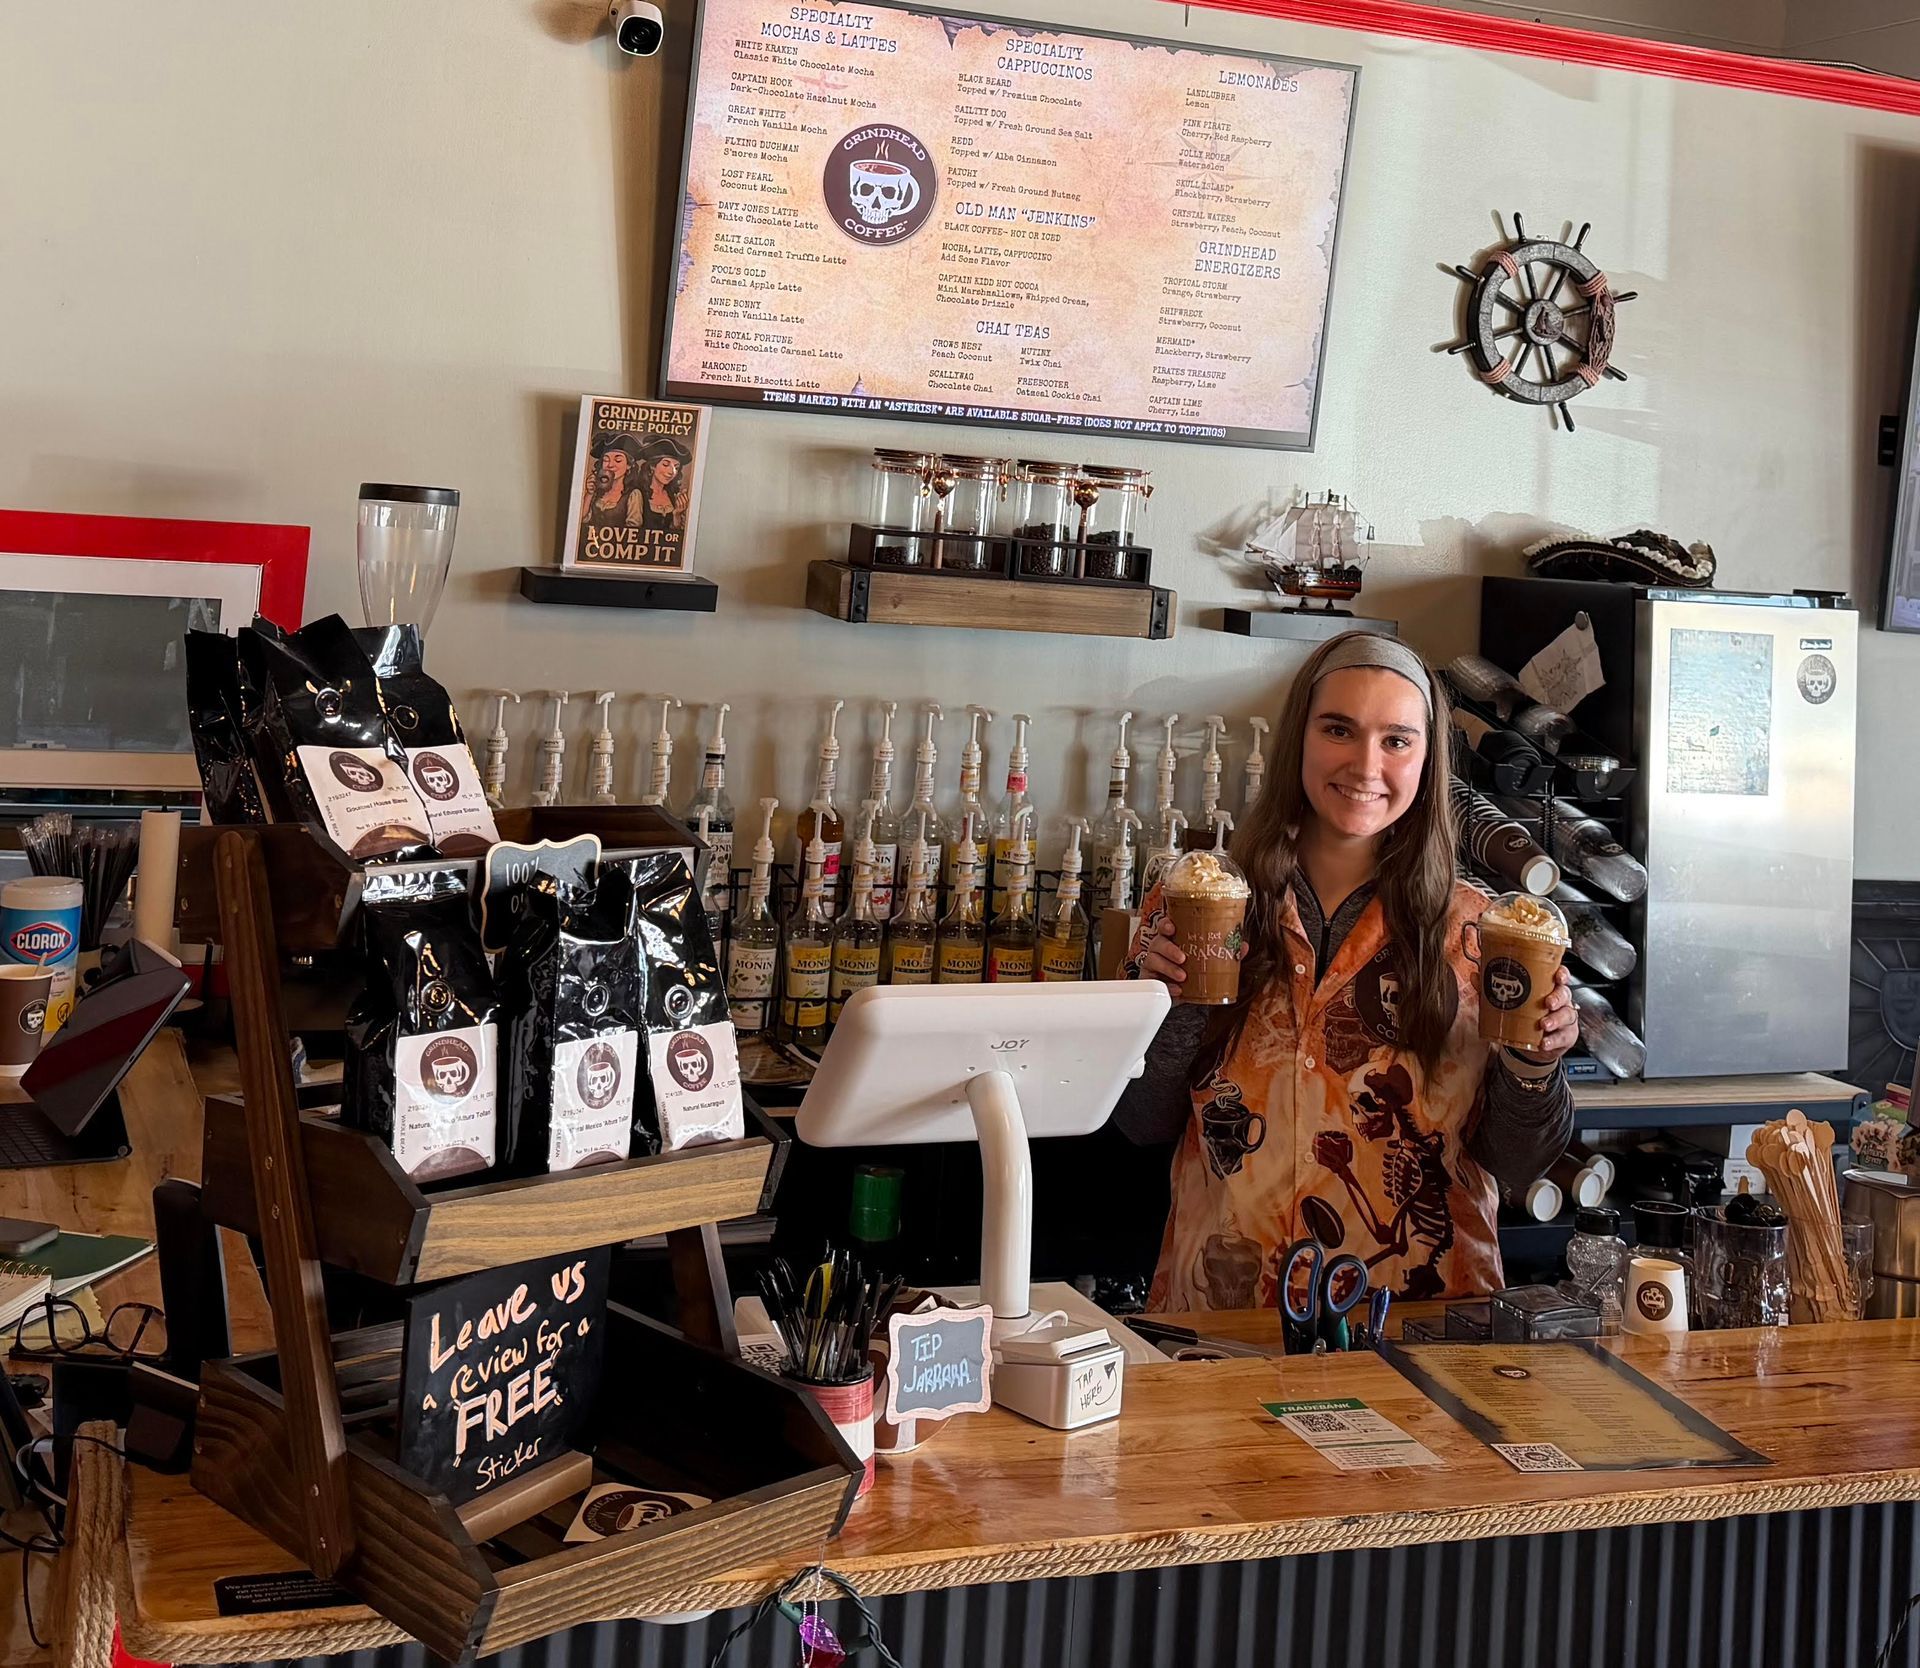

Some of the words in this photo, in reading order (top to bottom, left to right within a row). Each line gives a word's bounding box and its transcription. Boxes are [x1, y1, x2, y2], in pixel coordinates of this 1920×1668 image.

[790, 6, 873, 30] SPECIALTY
[760, 22, 820, 42] MOCHAS
[825, 31, 835, 44] &
[840, 32, 896, 52] LATTES
[735, 39, 762, 50] WHITE
[765, 43, 798, 55] KRAKEN
[1006, 38, 1084, 60] SPECIALTY
[733, 49, 769, 62] Classic
[772, 55, 797, 66] White
[799, 59, 845, 72] Chocolate
[847, 66, 874, 76] Mocha
[997, 56, 1092, 80] CAPPUCCINOS
[731, 71, 767, 83] CAPTAIN
[770, 76, 792, 87] HOOK
[958, 73, 983, 83] BLACK
[985, 76, 1011, 87] BEARD
[1218, 70, 1297, 92] LEMONADES
[1186, 87, 1235, 101] LANDLUBBER
[1185, 98, 1209, 108] Lemon
[728, 104, 756, 115] GREAT
[758, 108, 786, 119] WHITE
[1182, 118, 1201, 127] PINK
[1203, 120, 1231, 131] PIRATE
[724, 136, 756, 147] FLYING
[759, 140, 799, 152] DUCHMAN
[842, 128, 926, 162] GRINDHEAD
[951, 136, 973, 145] REDD
[721, 168, 744, 178] LOST
[746, 171, 773, 182] PEARL
[947, 166, 977, 177] PATCHY
[720, 179, 757, 191] Coconut
[760, 184, 787, 194] Mocha
[718, 200, 740, 210] DAVY
[741, 203, 769, 214] JONES
[772, 206, 798, 217] LATTE
[955, 201, 983, 216] OLD
[988, 205, 1016, 220] MAN
[1172, 208, 1205, 219] CRYSTAL
[1207, 212, 1236, 222] WATERS
[844, 217, 905, 239] COFFEE
[944, 222, 969, 232] BLACK
[1010, 229, 1026, 238] HOT
[1028, 231, 1039, 239] OR
[1041, 232, 1061, 242] ICED
[714, 233, 741, 243] SALTY
[743, 236, 775, 246] SAILOR
[942, 242, 971, 254] MOCHA,
[973, 245, 1001, 257] LATTE,
[1003, 249, 1052, 261] CAPPUCCINO
[1199, 240, 1276, 260] GRINDHEAD
[743, 268, 766, 277] GOLD
[1194, 259, 1280, 279] ENERGIZERS
[938, 273, 972, 284] CAPTAIN
[974, 277, 994, 286] KIDD
[996, 279, 1012, 288] HOT
[1014, 281, 1038, 291] COCOA
[1163, 276, 1200, 287] TROPICAL
[1202, 280, 1227, 290] STORM
[708, 297, 731, 306] ANNE
[733, 299, 761, 309] BONNY
[1159, 306, 1203, 318] SHIPWRECK
[704, 328, 722, 338] THE
[724, 330, 751, 340] ROYAL
[754, 333, 792, 344] FORTUNE
[976, 320, 1010, 336] CHAI
[1014, 324, 1049, 339] TEAS
[932, 338, 958, 348] CROWS
[961, 341, 982, 350] NEST
[1020, 347, 1051, 356] MUTINY
[701, 360, 747, 372] MAROONED
[1152, 366, 1185, 376] PIRATES
[1187, 369, 1226, 379] TREASURE
[928, 369, 973, 380] SCALLYWAG
[1017, 377, 1069, 388] FREEBOOTER
[1149, 395, 1180, 405] CAPTAIN
[1182, 398, 1202, 407] LIME
[598, 404, 694, 425] GRINDHEAD
[763, 390, 796, 402] ITEMS
[798, 394, 838, 406] MARKED
[841, 397, 866, 408] WITH
[868, 399, 881, 409] AN
[944, 406, 964, 416] ARE
[966, 407, 1018, 420] AVAILABLE
[1020, 412, 1082, 425] SUGAR-FREE
[1113, 419, 1132, 429] NOT
[1134, 421, 1162, 432] APPLY
[1164, 423, 1176, 433] TO
[598, 419, 644, 432] COFFEE
[648, 422, 692, 436] POLICY
[588, 525, 639, 543] LOVE
[644, 529, 664, 545] IT
[665, 533, 679, 543] OR
[585, 542, 648, 561] COMP
[654, 546, 676, 562] IT
[16, 932, 66, 950] CLOROX
[1207, 932, 1221, 942] get
[736, 960, 772, 970] MONIN
[839, 960, 876, 969] MONIN
[991, 1040, 1030, 1049] JOY
[700, 1100, 725, 1109] Nicaragua
[430, 1283, 537, 1374] Leave
[551, 1260, 587, 1304] us
[910, 1333, 943, 1362] TIP
[423, 1393, 437, 1410] a
[451, 1338, 528, 1400] review
[536, 1319, 571, 1354] for
[577, 1317, 592, 1337] a
[1075, 1368, 1094, 1391] TAP
[1080, 1380, 1102, 1410] HERE
[1280, 1403, 1351, 1413] TRADEBANK
[475, 1437, 542, 1490] Sticker
